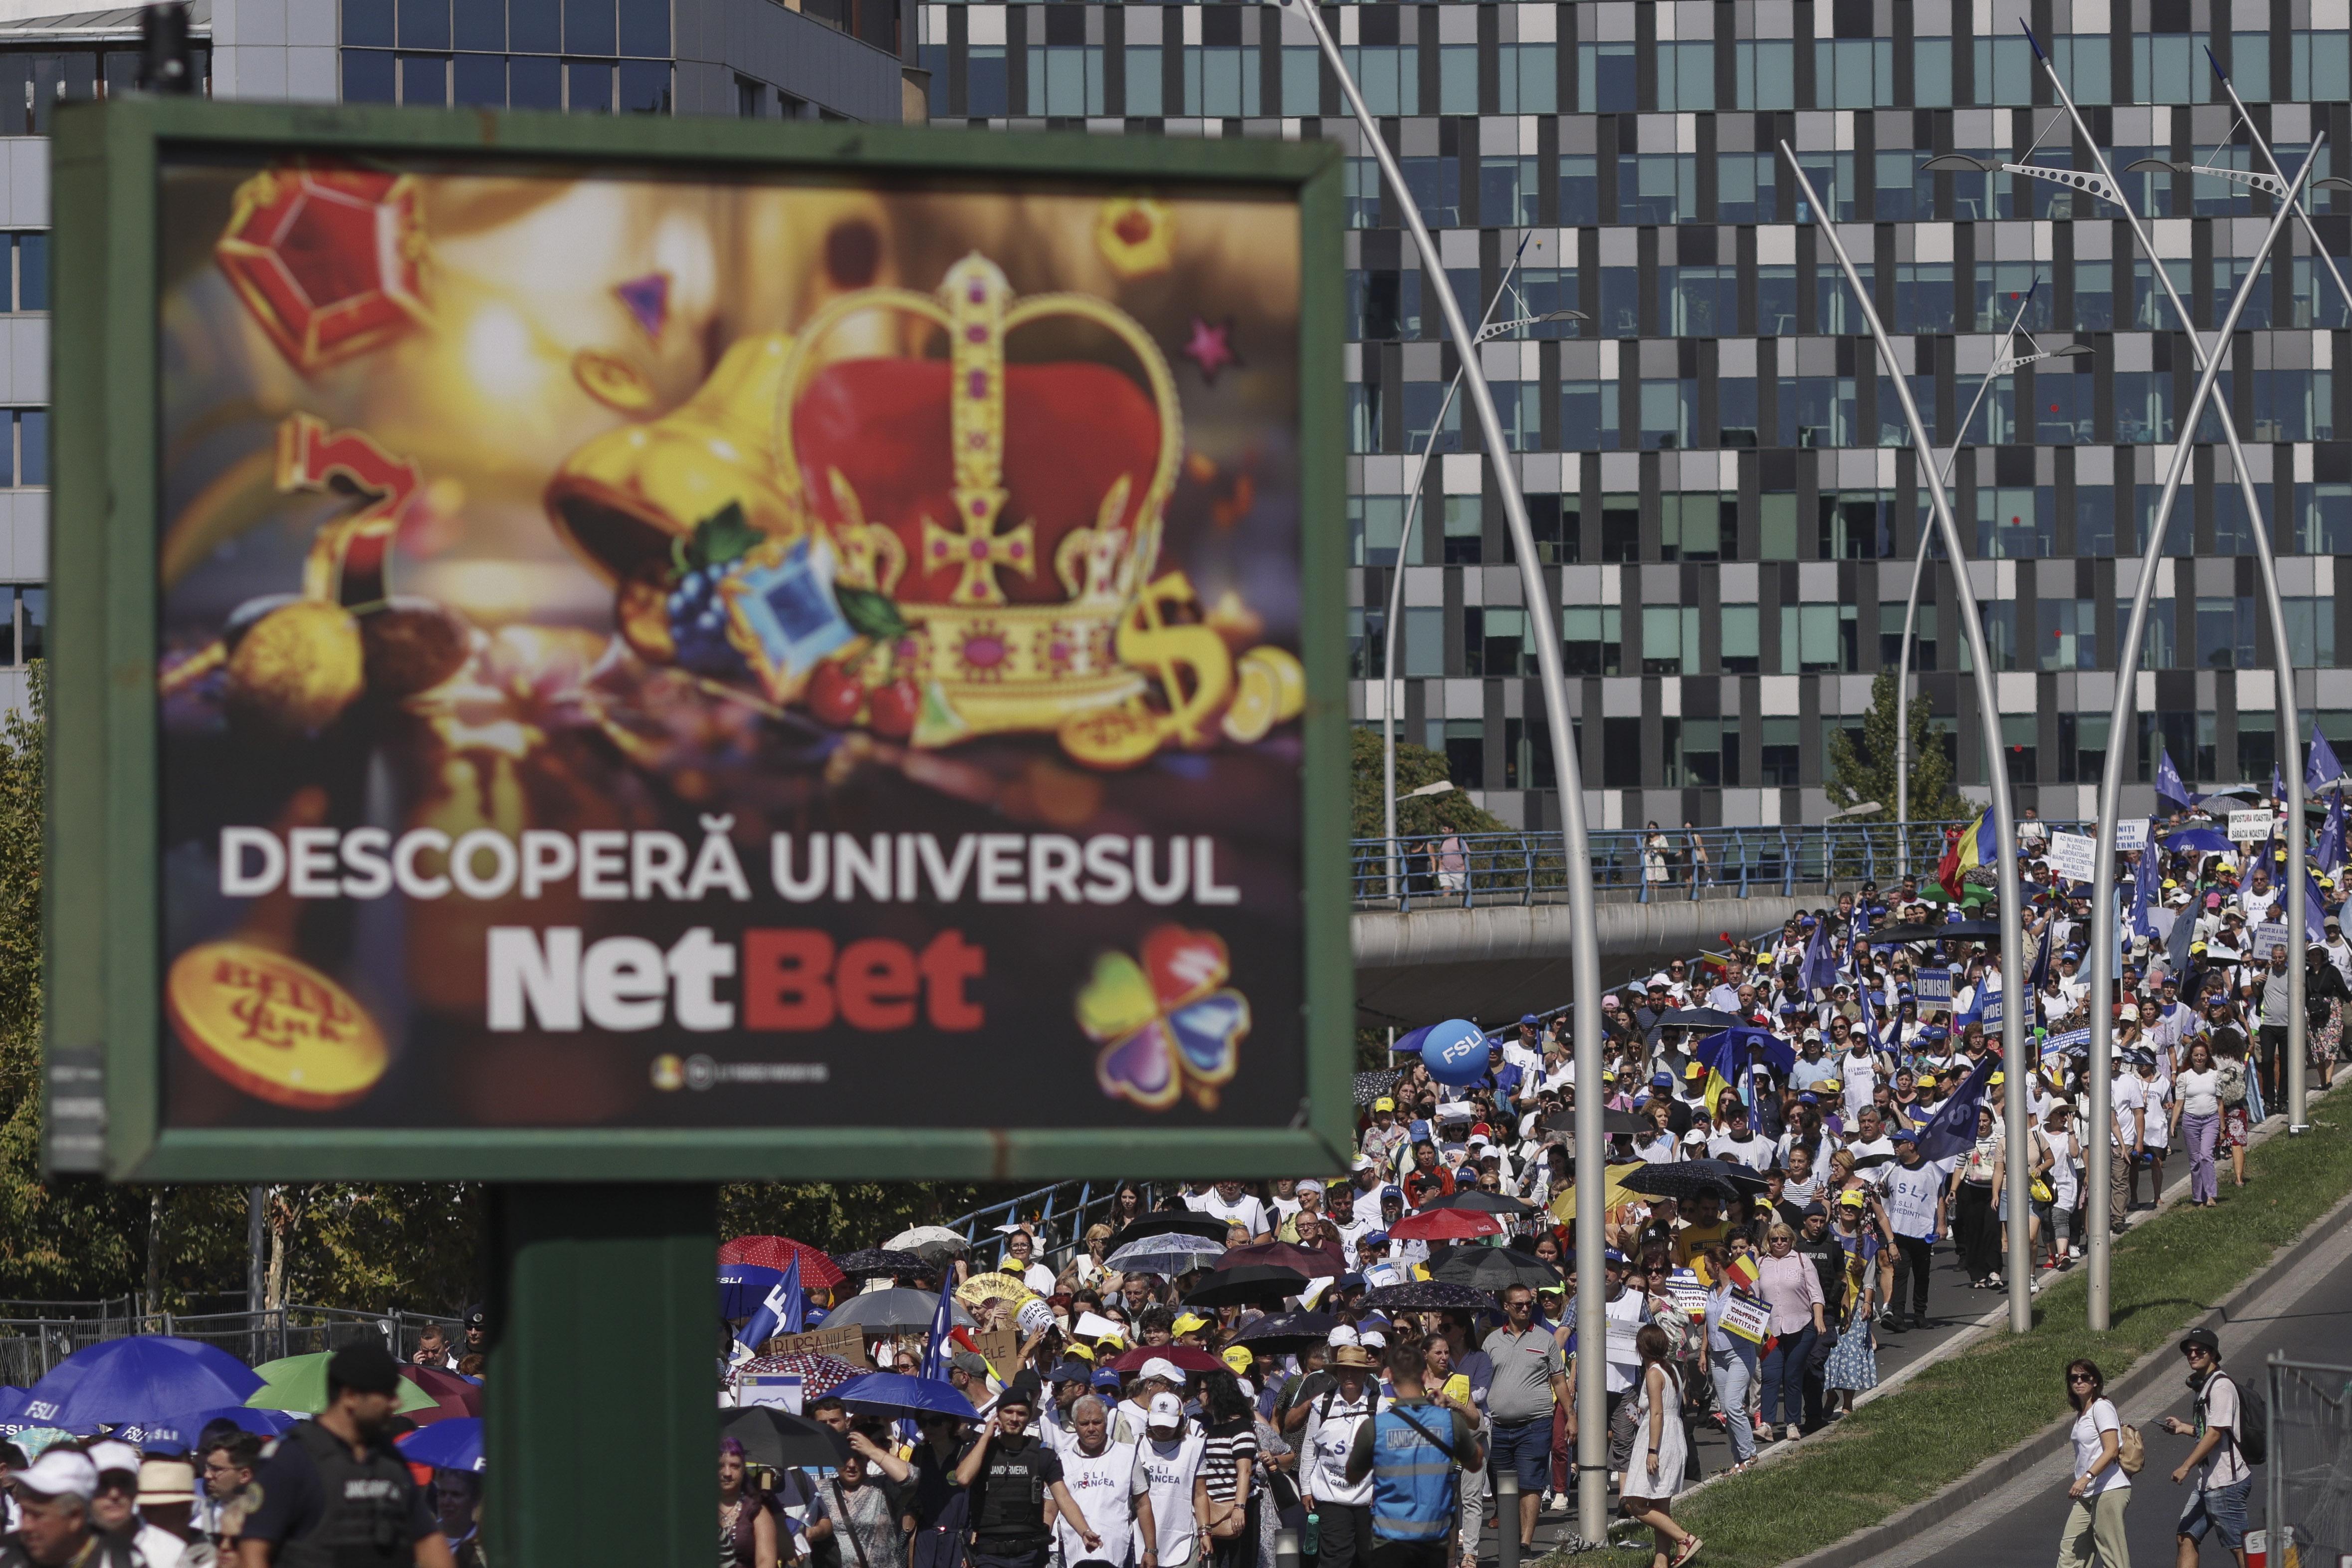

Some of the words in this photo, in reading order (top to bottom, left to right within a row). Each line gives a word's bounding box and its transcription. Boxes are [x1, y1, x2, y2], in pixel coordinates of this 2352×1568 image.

[2118, 825, 2135, 834] NIȚI
[218, 814, 751, 899] DESCOPERĂ
[770, 831, 1241, 904] UNIVERSUL
[486, 926, 985, 1032] NetBet
[1918, 979, 1950, 997] DEMISIA
[1442, 1030, 1483, 1065] FSLI
[1726, 1314, 1759, 1333] CANTITATE
[774, 1336, 823, 1355] BURSA
[826, 1332, 840, 1350] NU
[844, 1329, 852, 1346] E
[24, 1400, 60, 1421] FSLI
[122, 1426, 149, 1443] FSLI
[1149, 1475, 1180, 1484] ANCEA
